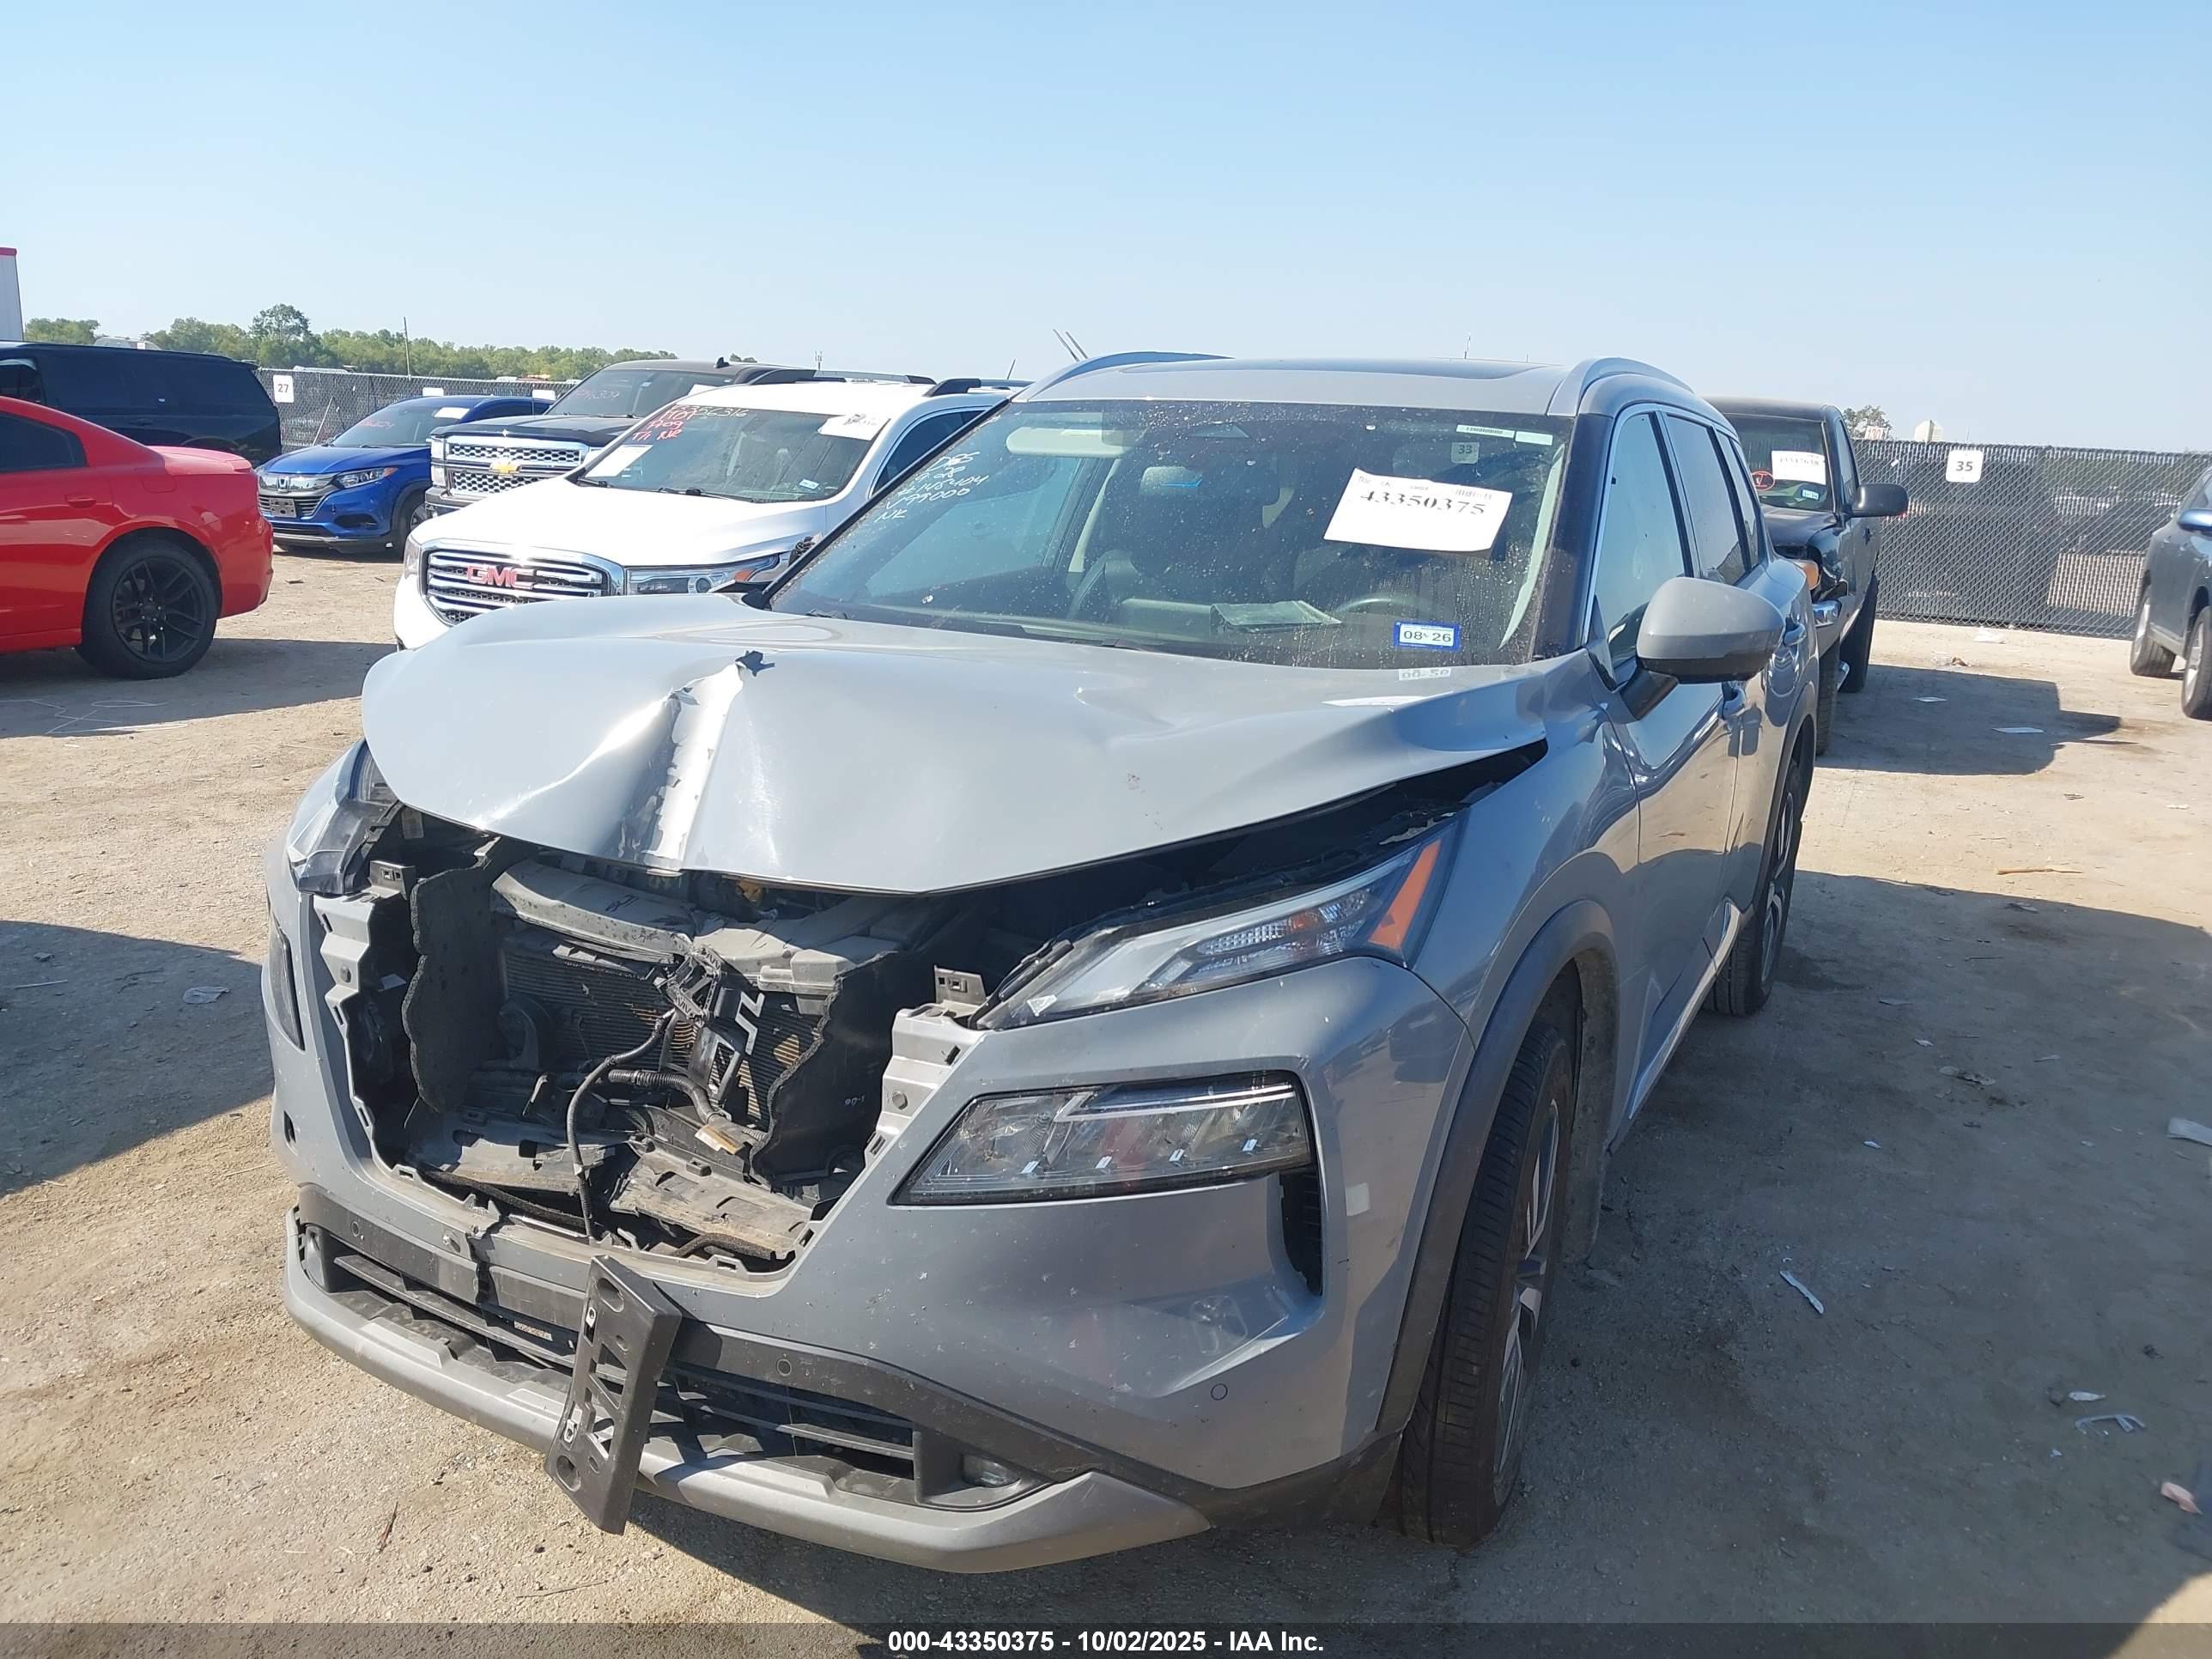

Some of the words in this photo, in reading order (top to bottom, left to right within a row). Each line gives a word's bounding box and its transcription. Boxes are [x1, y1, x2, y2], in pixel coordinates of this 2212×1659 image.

[277, 383, 289, 393] 27
[1955, 460, 1974, 472] 35
[1360, 490, 1486, 515] 43350375
[466, 563, 534, 590] GMC
[1403, 630, 1423, 641] 08
[1432, 632, 1451, 642] 26
